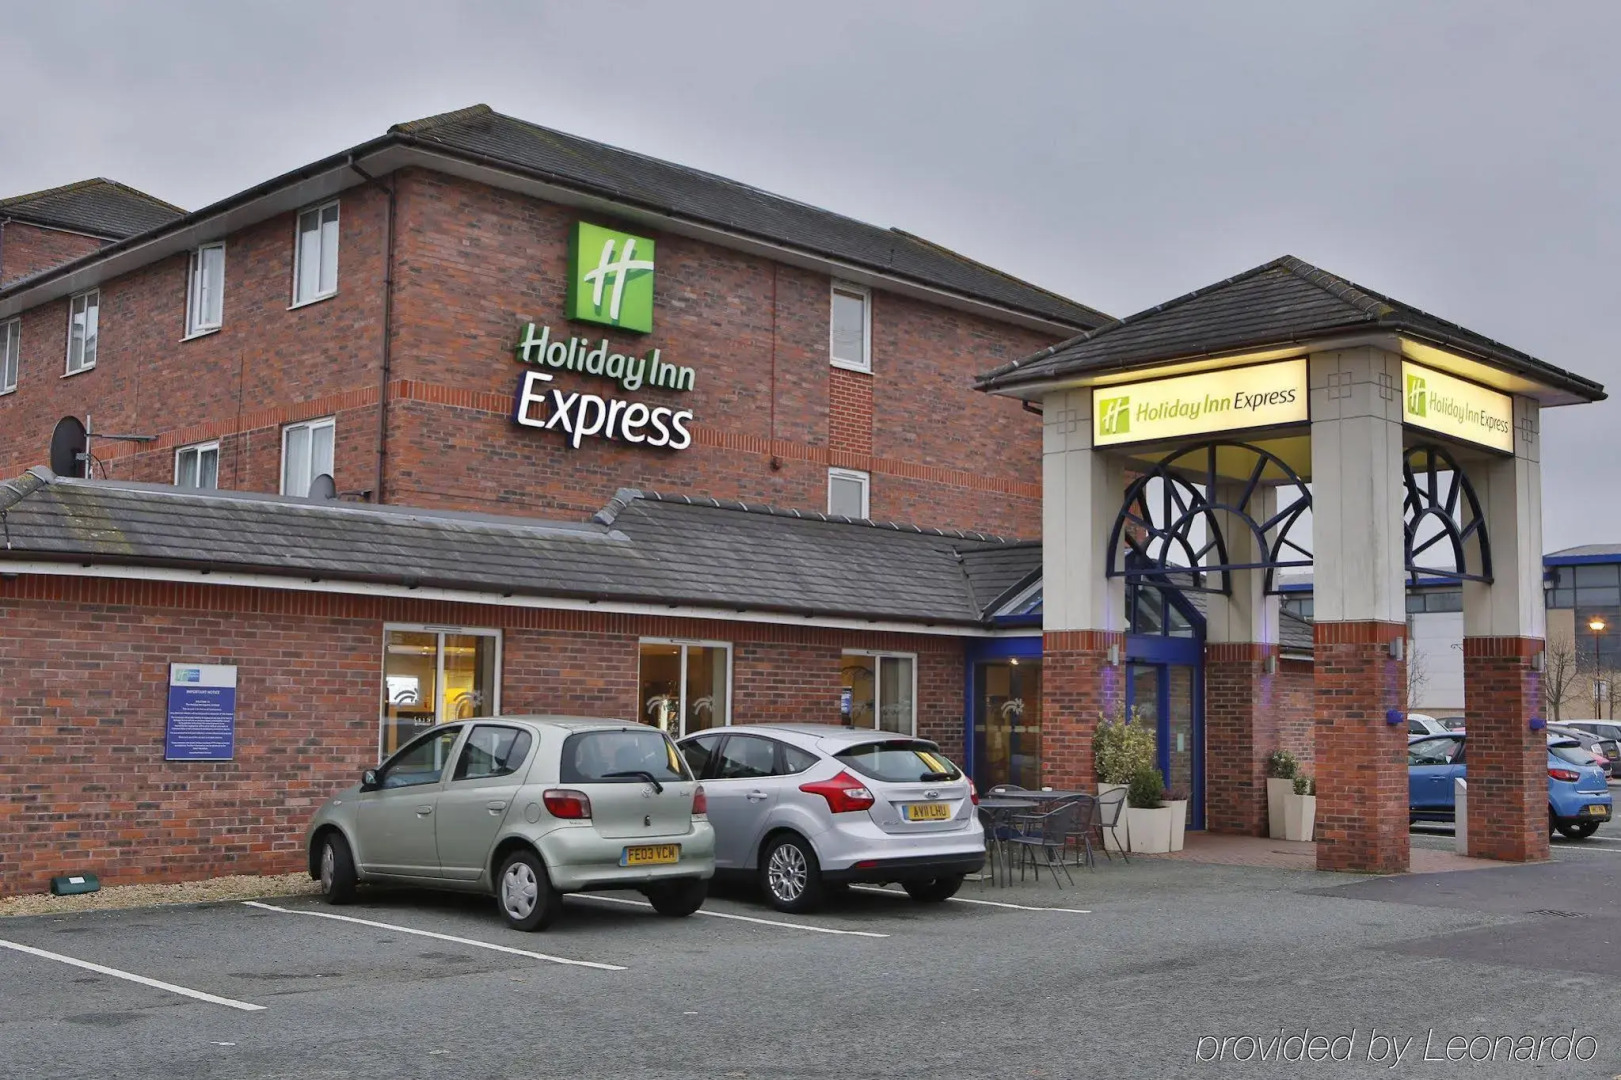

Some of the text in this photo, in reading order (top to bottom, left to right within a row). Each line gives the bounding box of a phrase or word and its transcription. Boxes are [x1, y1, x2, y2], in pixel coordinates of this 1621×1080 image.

[519, 322, 696, 392] Holiday Inn
[516, 370, 693, 451] Express
[1135, 388, 1297, 423] Holiday Inn Express
[1429, 390, 1509, 434] Holiday Inn Express
[628, 847, 654, 861] FE03
